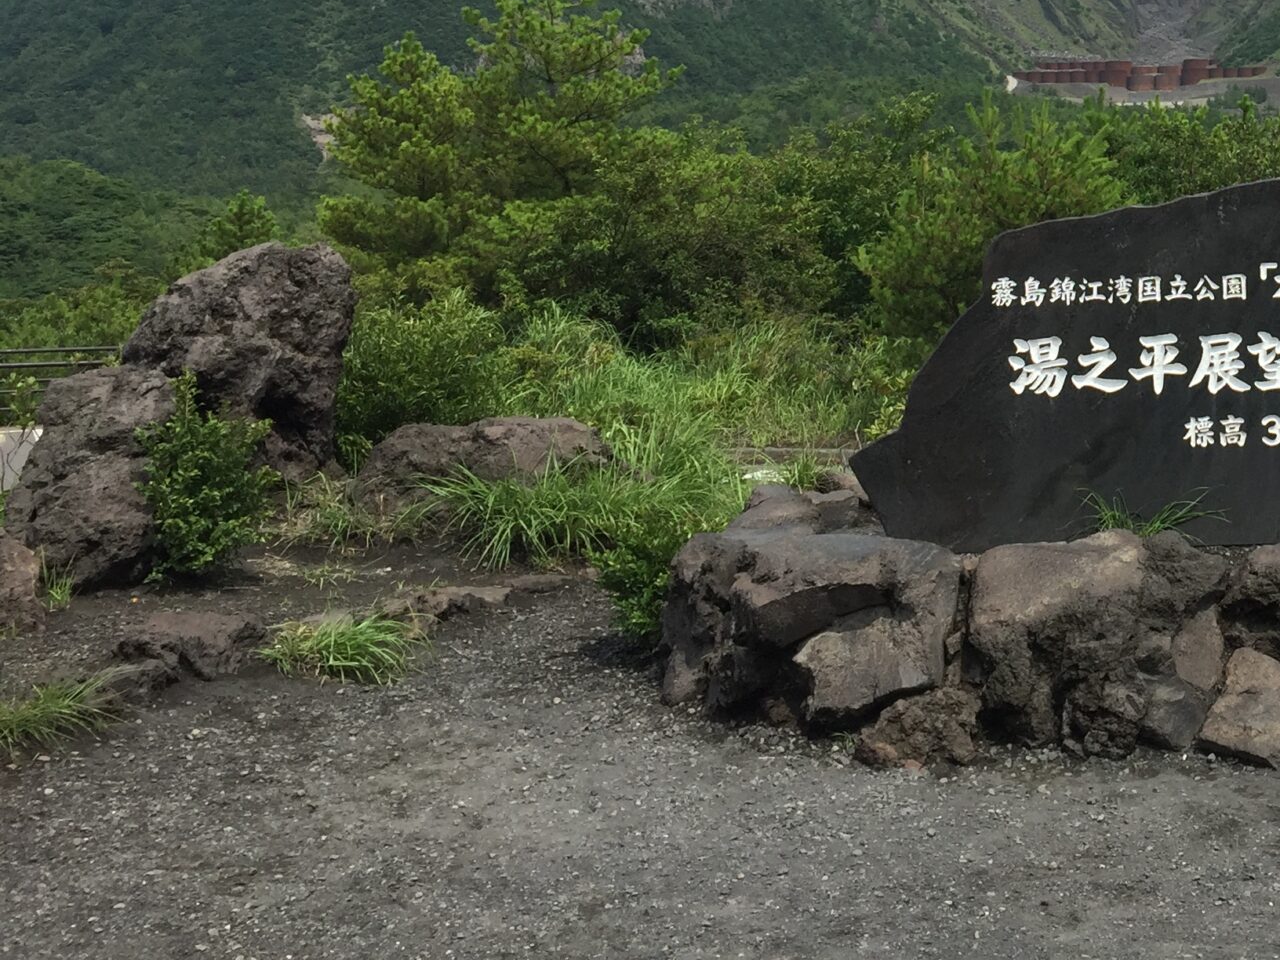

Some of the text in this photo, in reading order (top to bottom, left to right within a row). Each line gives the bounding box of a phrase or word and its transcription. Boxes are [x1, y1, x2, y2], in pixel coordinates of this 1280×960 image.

[990, 273, 1247, 308] 霧島錦江湾国立公園
[1182, 414, 1247, 448] 標高
